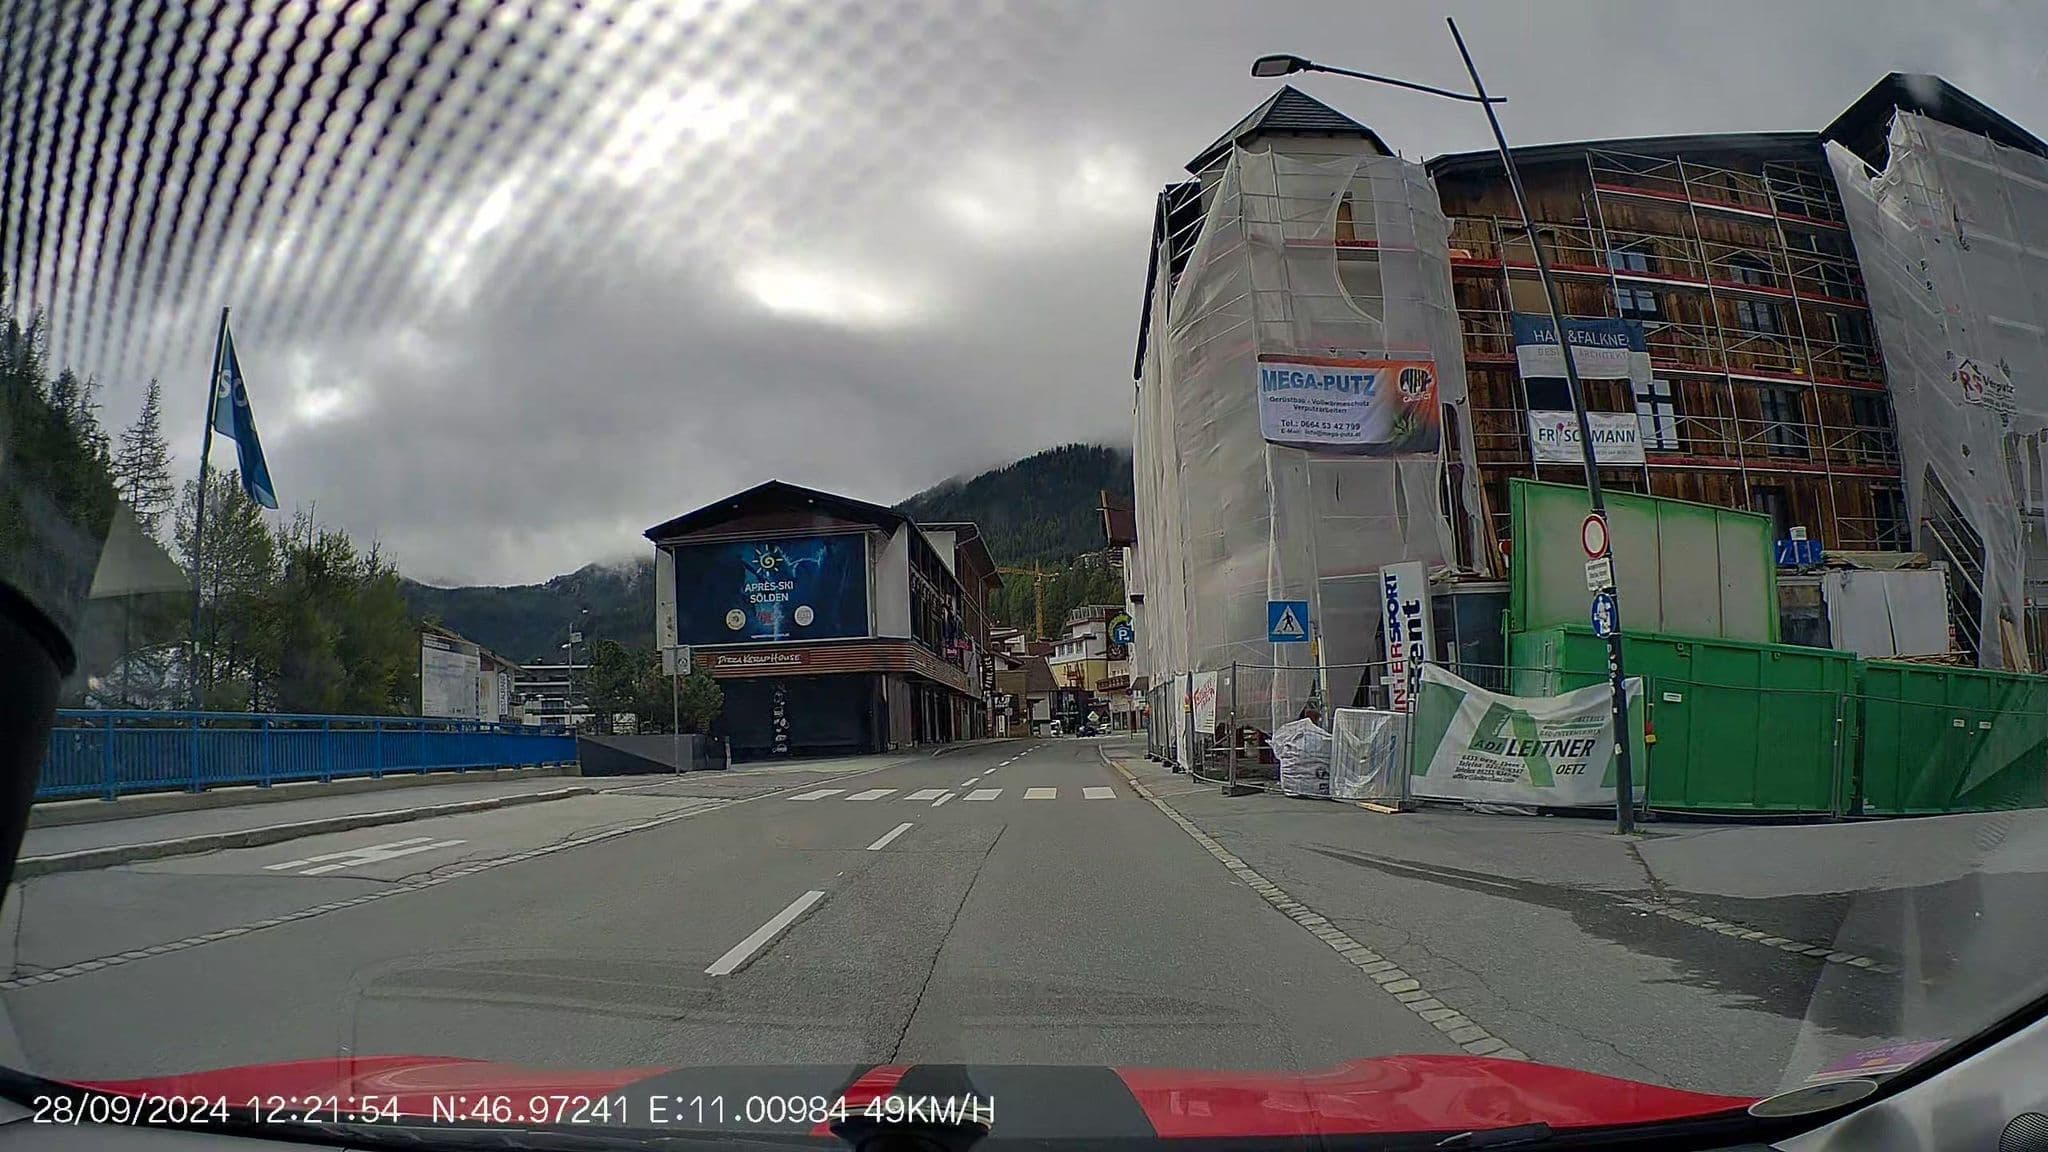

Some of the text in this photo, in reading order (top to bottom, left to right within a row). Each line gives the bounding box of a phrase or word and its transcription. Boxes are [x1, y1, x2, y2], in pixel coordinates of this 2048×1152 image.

[1262, 368, 1376, 396] MEGA-PUTZ
[1334, 422, 1343, 430] 42
[1538, 427, 1636, 443] FRISCMANN
[745, 580, 794, 592] APRÈS-SKI
[750, 593, 789, 603] SÖLDEN
[1118, 629, 1128, 641] P
[1383, 570, 1408, 714] INTERSPORT
[1505, 738, 1596, 758] LEITNER
[1555, 763, 1587, 775] OETZ
